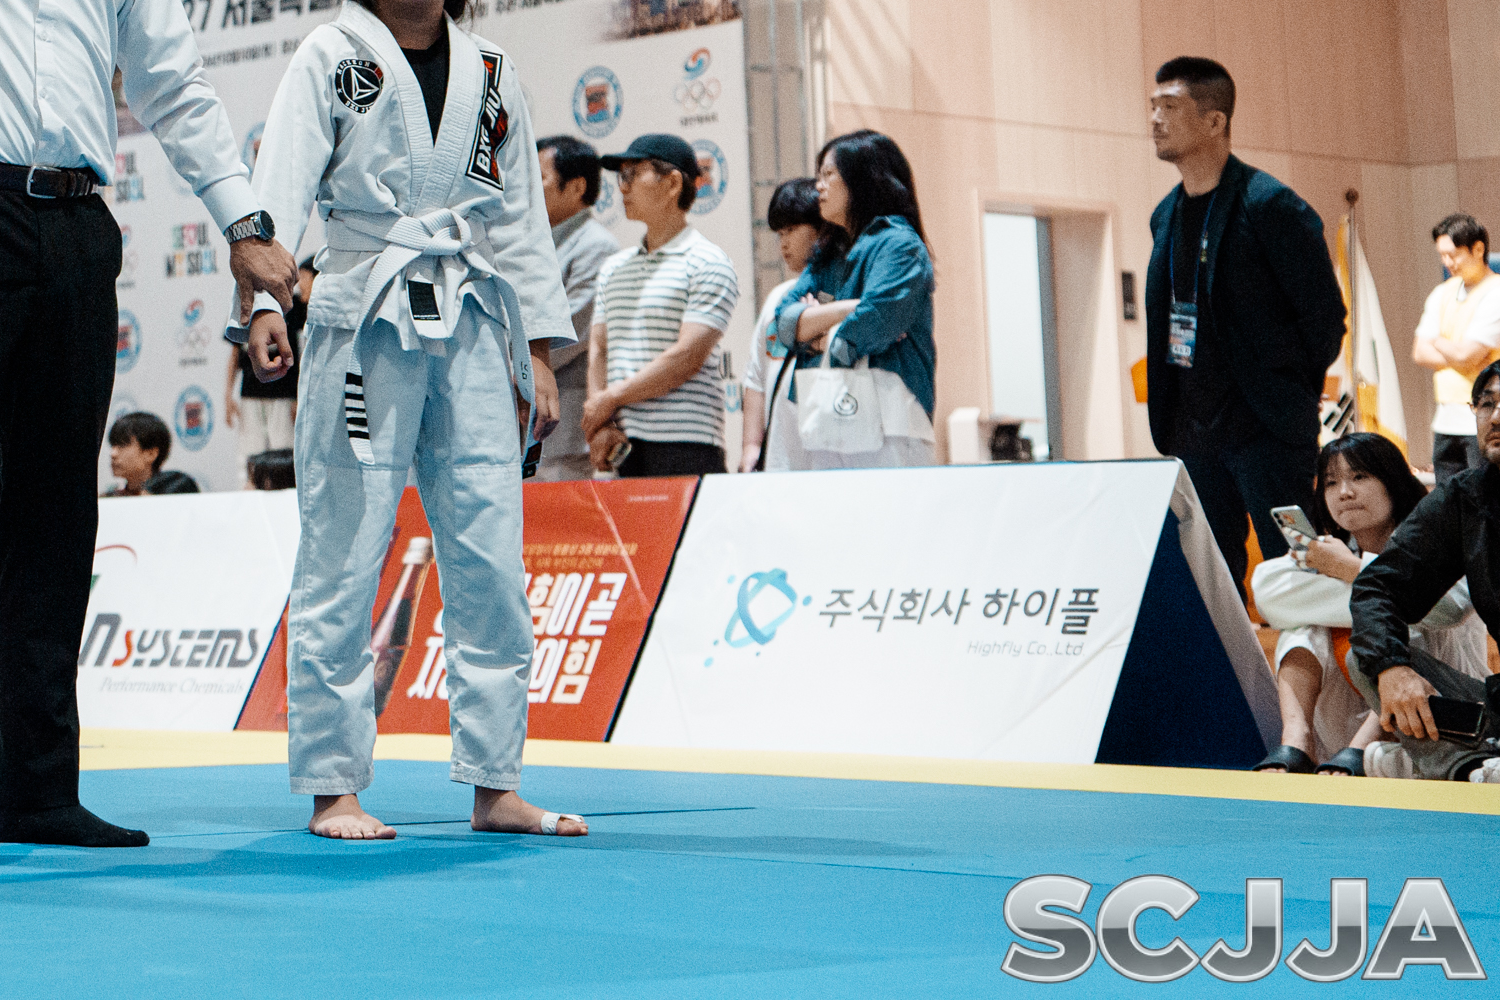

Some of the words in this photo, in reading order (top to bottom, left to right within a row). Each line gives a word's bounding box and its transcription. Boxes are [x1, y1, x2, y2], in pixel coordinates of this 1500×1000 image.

[485, 87, 502, 130] JIU
[819, 588, 971, 633] 주식회사
[982, 588, 1100, 635] 하이플
[967, 640, 1022, 657] Highfly
[100, 676, 175, 694] Performance
[180, 676, 244, 695] Chemicals
